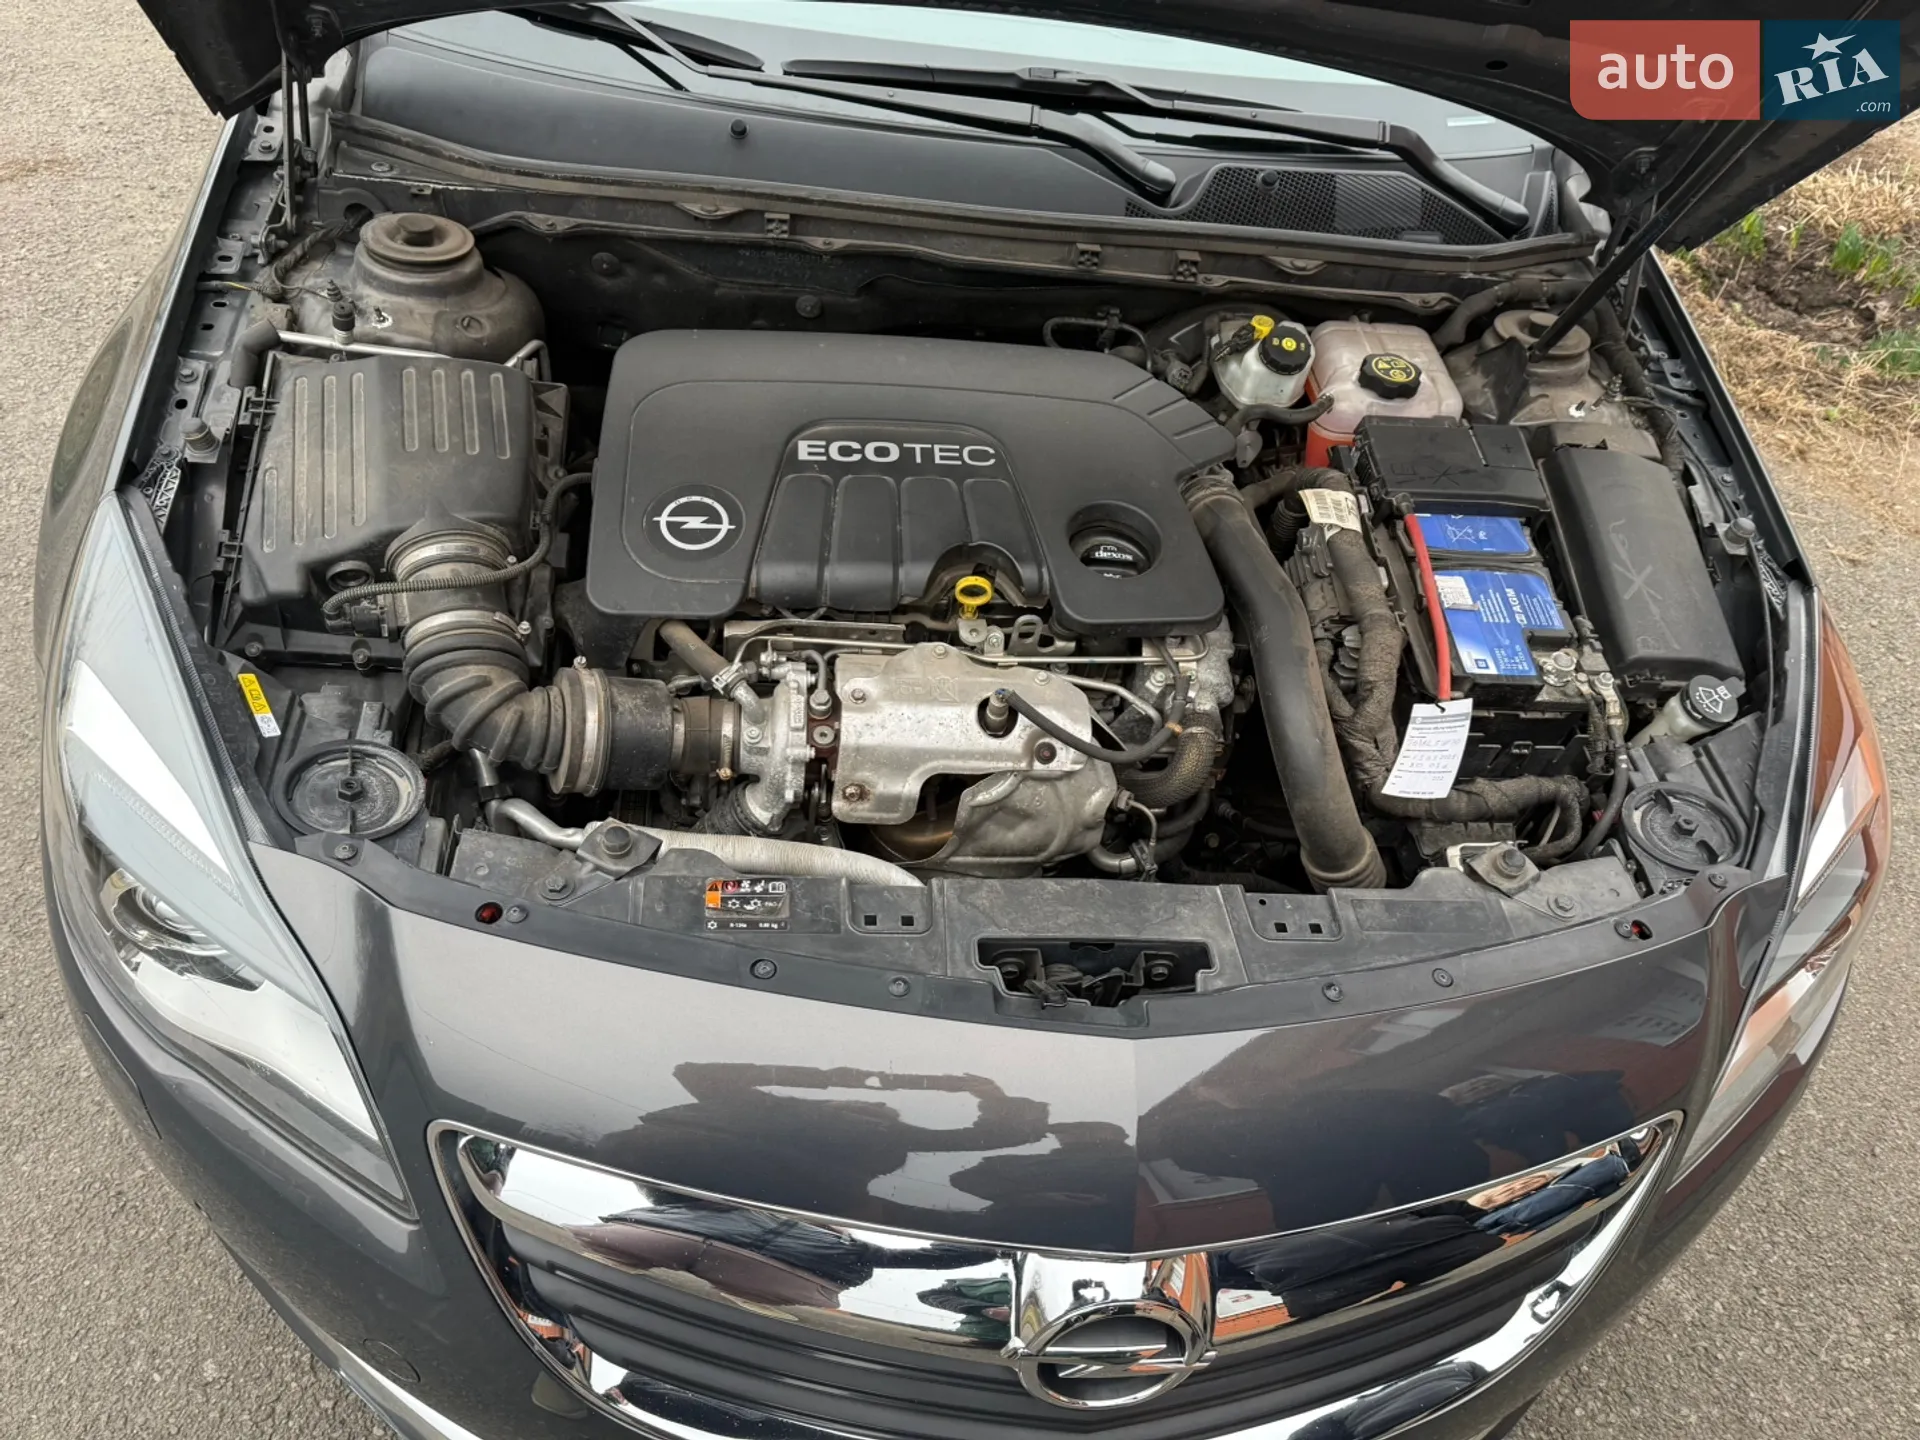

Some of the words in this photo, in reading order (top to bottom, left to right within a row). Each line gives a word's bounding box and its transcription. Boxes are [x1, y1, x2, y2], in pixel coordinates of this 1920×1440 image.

[797, 439, 996, 467] ECOTEC
[1095, 550, 1132, 561] dexos
[1505, 588, 1525, 617] AGM
